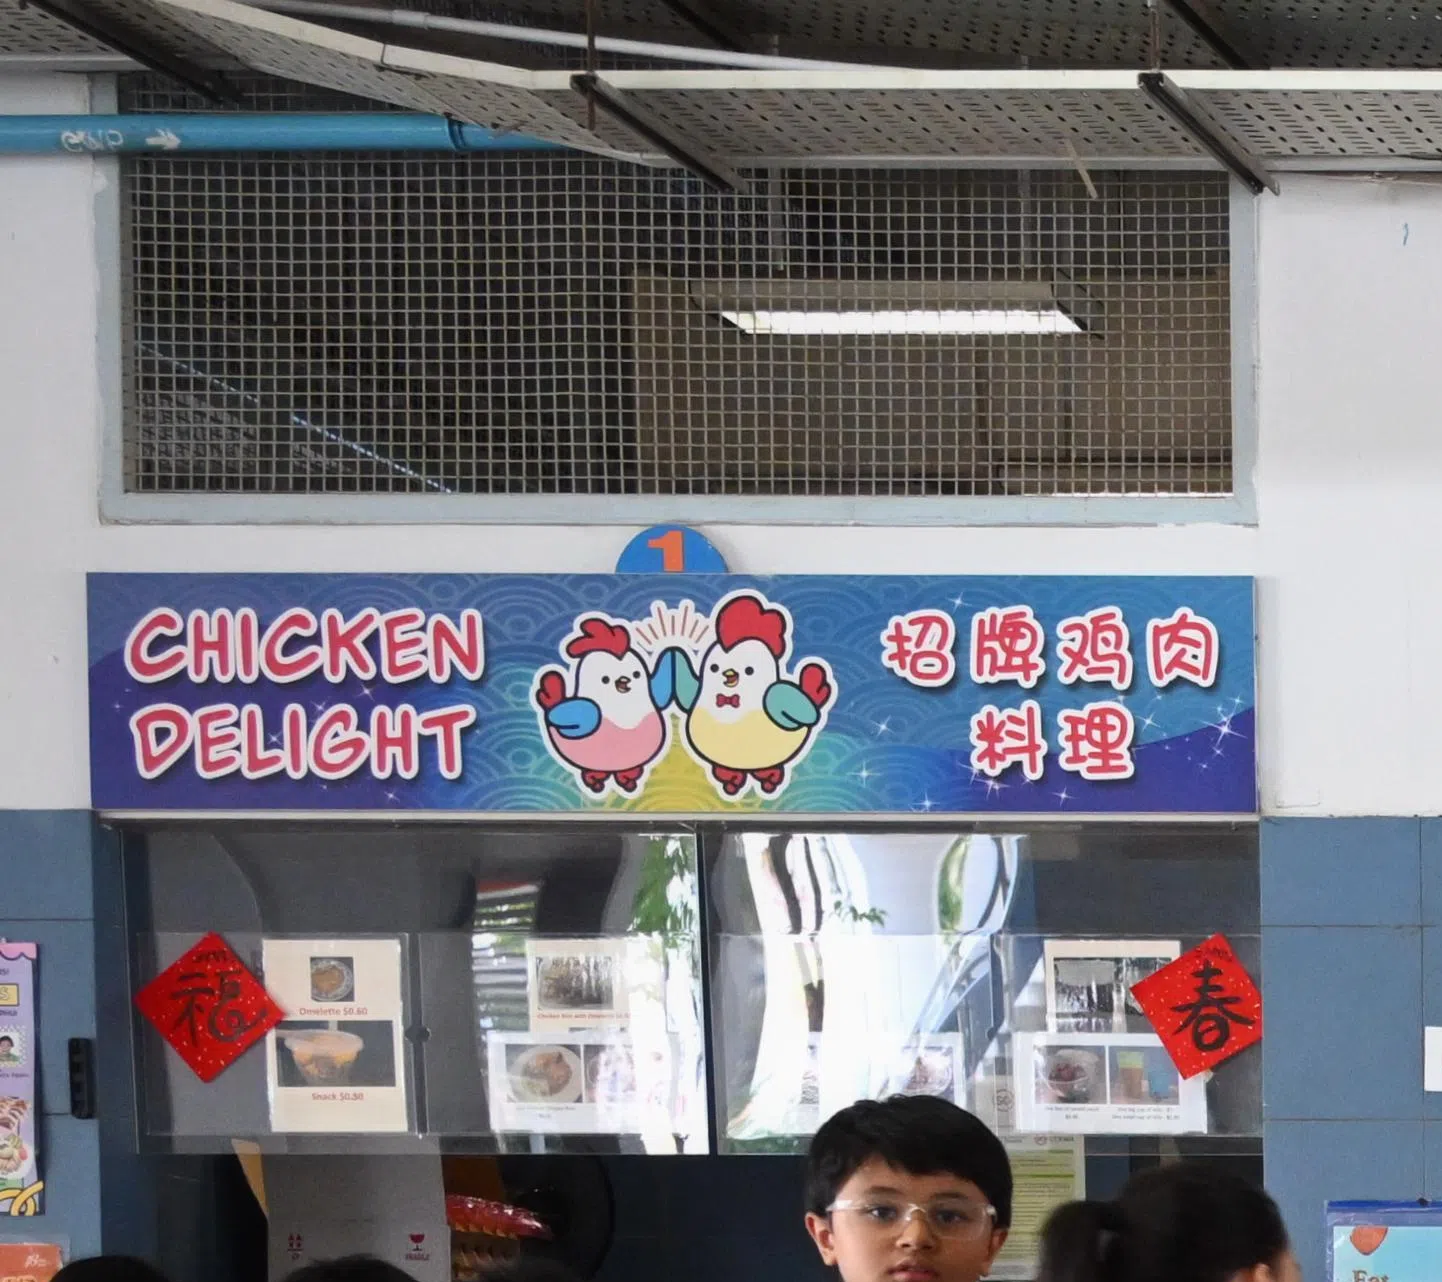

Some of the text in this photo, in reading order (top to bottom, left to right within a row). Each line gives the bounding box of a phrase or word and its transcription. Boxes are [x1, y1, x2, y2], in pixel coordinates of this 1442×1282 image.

[649, 530, 687, 571] 1
[124, 608, 486, 687] CHICKEN
[883, 606, 1220, 688] 招牌鸡肉
[133, 703, 477, 778] DELIGHT
[971, 701, 1135, 780] 料理
[168, 966, 269, 1046] 福
[1171, 962, 1256, 1052] 春
